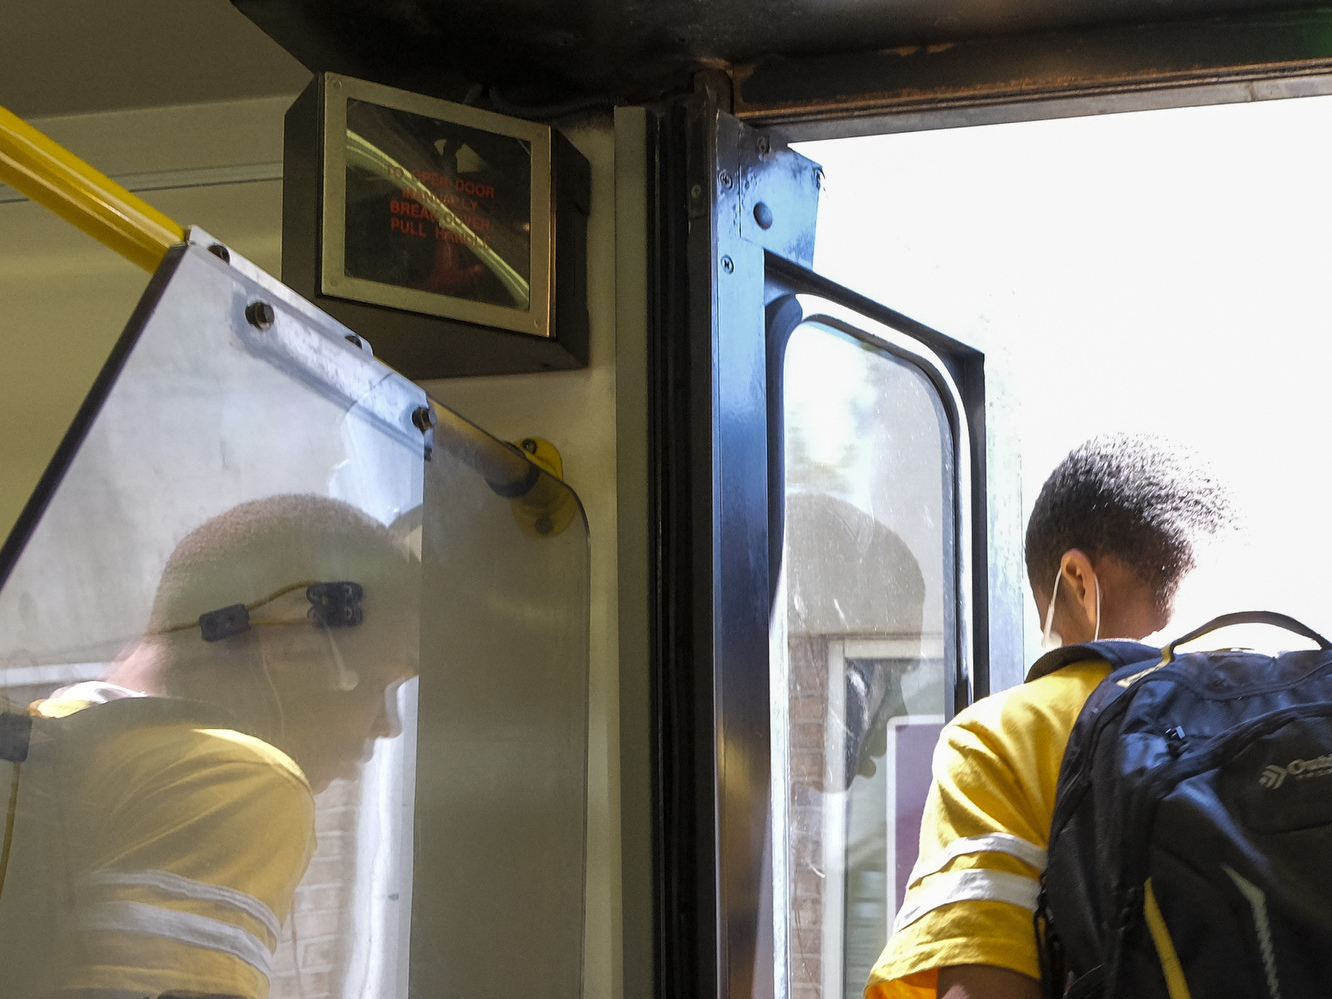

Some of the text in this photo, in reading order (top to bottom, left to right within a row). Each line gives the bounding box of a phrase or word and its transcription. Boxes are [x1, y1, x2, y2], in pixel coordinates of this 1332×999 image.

[412, 169, 449, 188] OPEN
[455, 178, 494, 199] DOOR
[390, 200, 439, 223] BREAK
[391, 217, 427, 238] PULL
